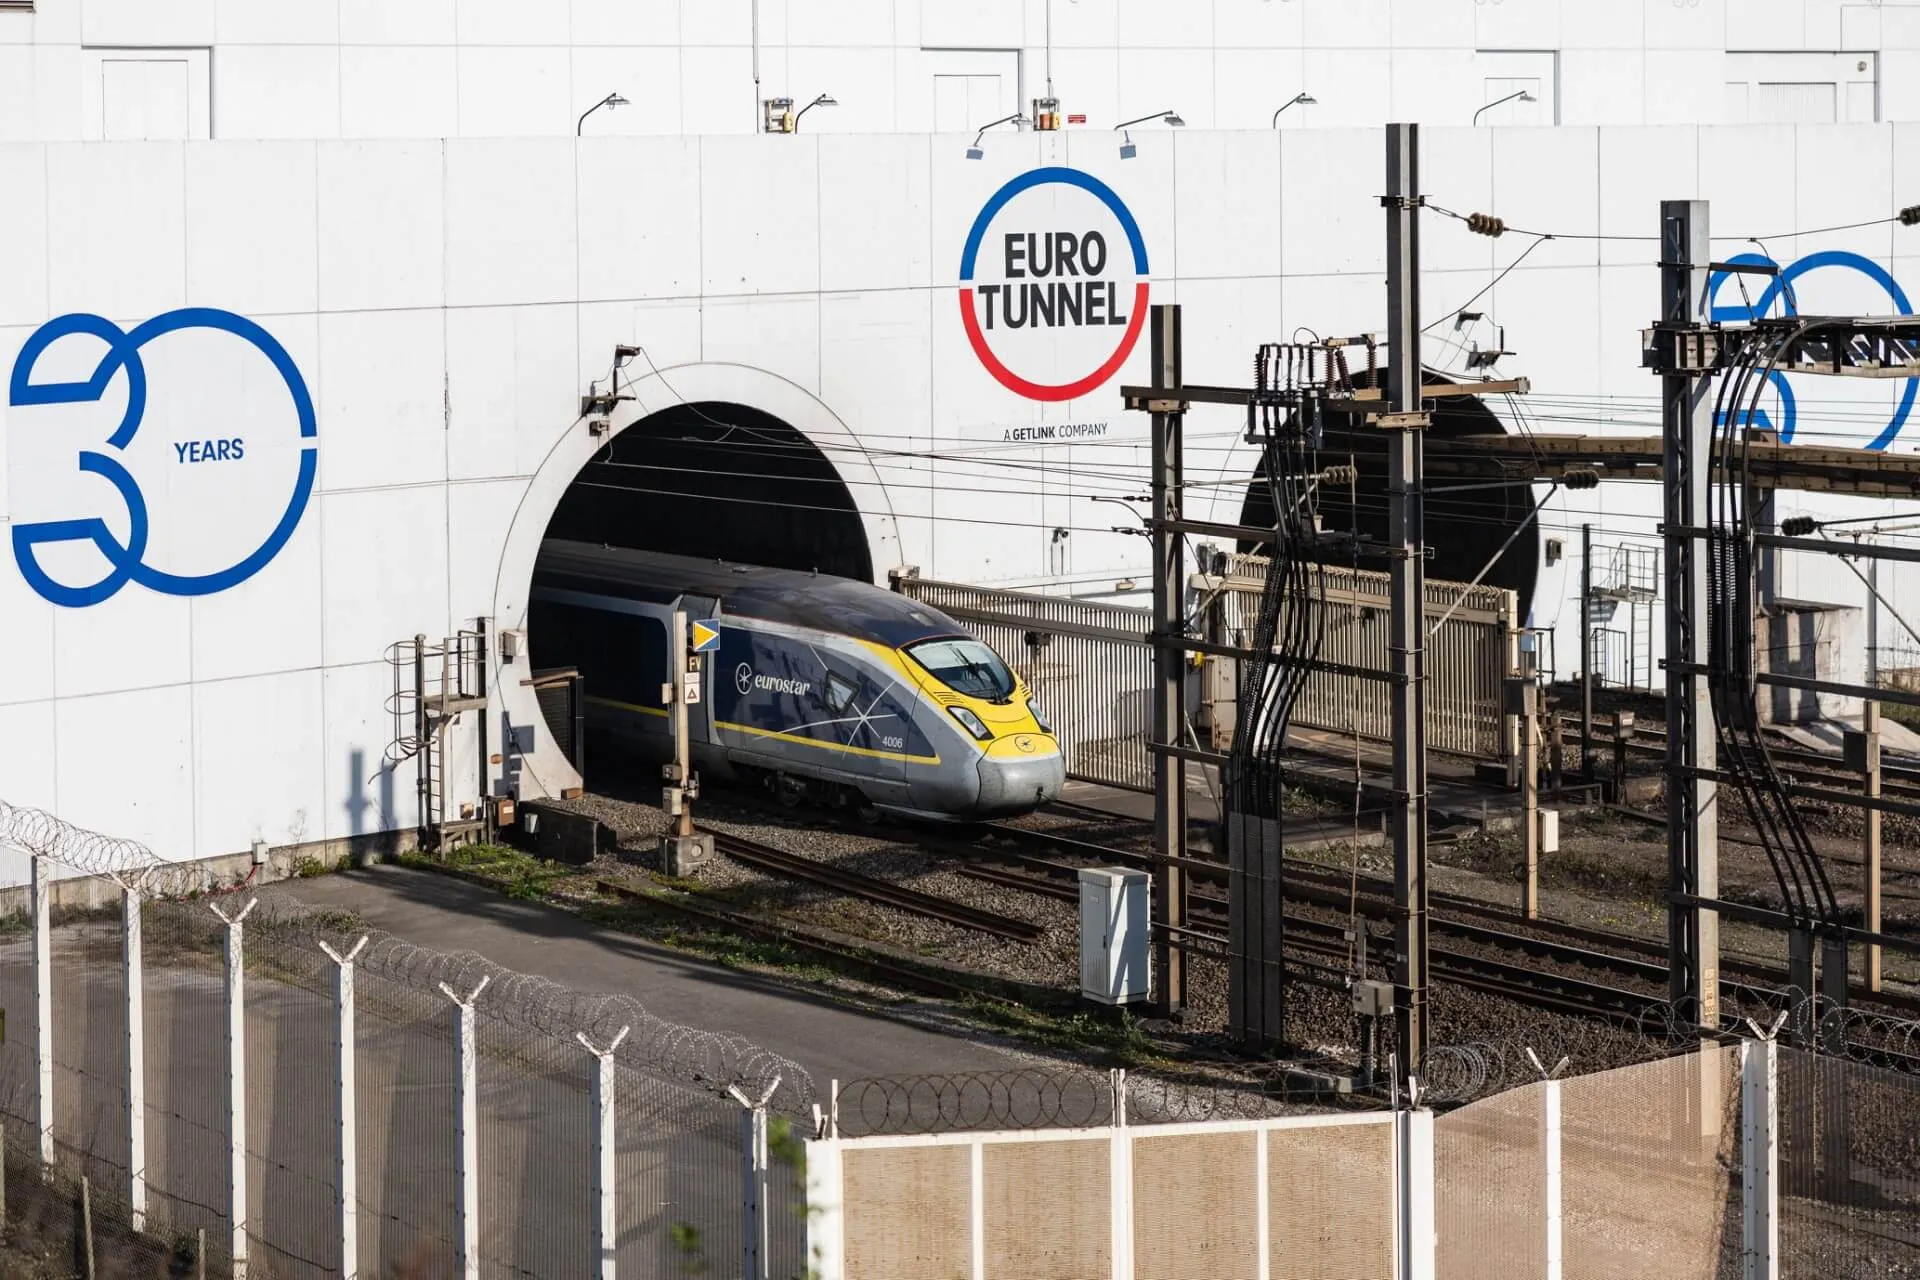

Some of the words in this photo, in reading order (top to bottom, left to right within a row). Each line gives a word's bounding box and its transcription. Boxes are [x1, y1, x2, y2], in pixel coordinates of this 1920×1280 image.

[1005, 231, 1107, 278] EURO
[978, 281, 1127, 330] TUNNEL
[1004, 429, 1011, 441] A
[1013, 426, 1055, 440] GETLINK
[1059, 422, 1108, 438] COMPANY
[9, 307, 318, 608] 30
[174, 438, 244, 464] YEARS
[755, 674, 811, 696] eurostar
[882, 736, 903, 749] 4006
